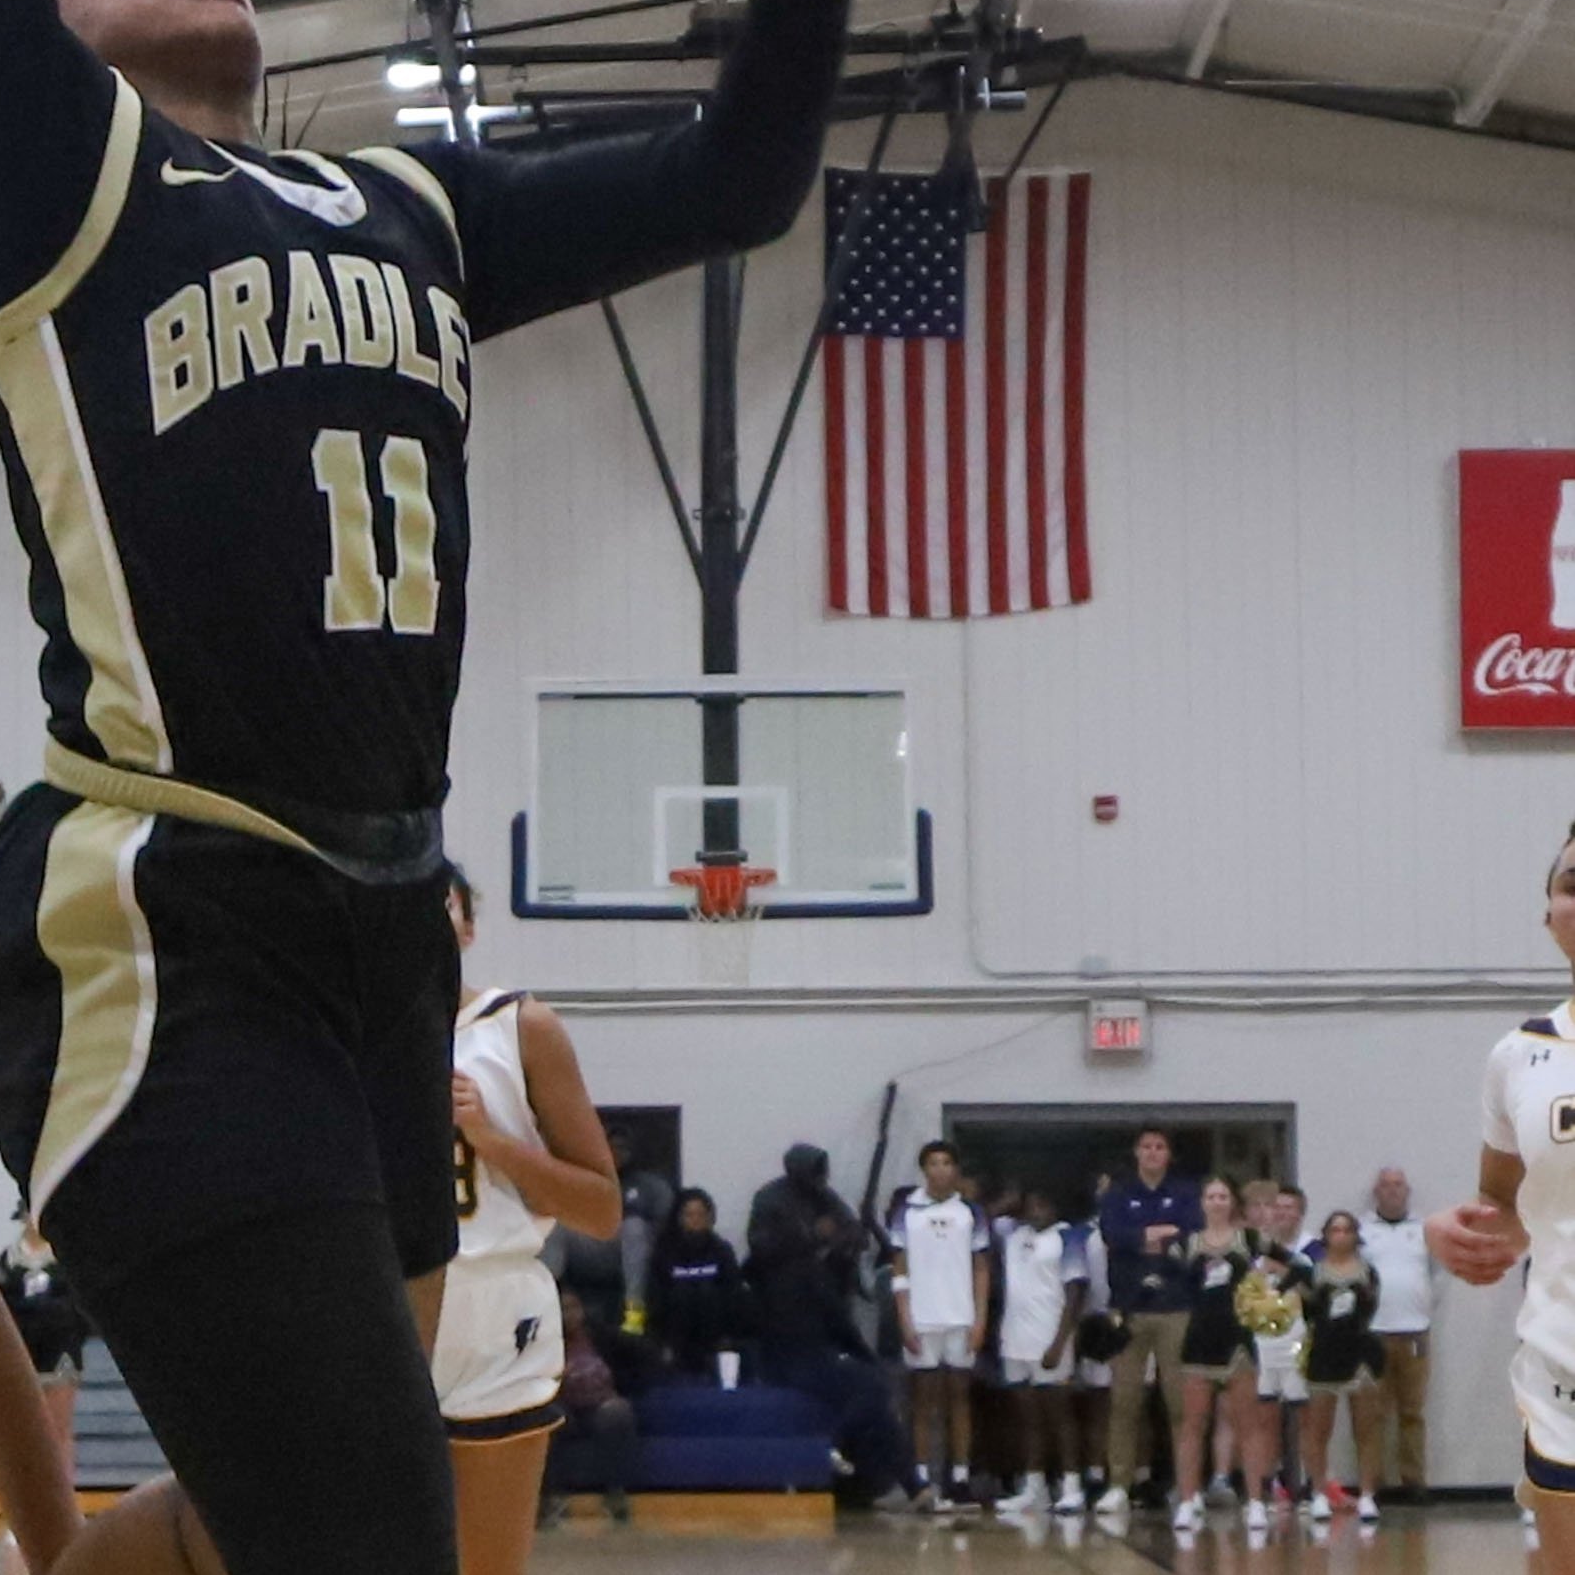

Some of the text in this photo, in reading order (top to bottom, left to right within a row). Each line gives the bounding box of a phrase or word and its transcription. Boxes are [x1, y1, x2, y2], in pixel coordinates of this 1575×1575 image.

[144, 250, 472, 436] BRADLE
[310, 428, 440, 635] 11
[1473, 633, 1575, 695] Coca-
